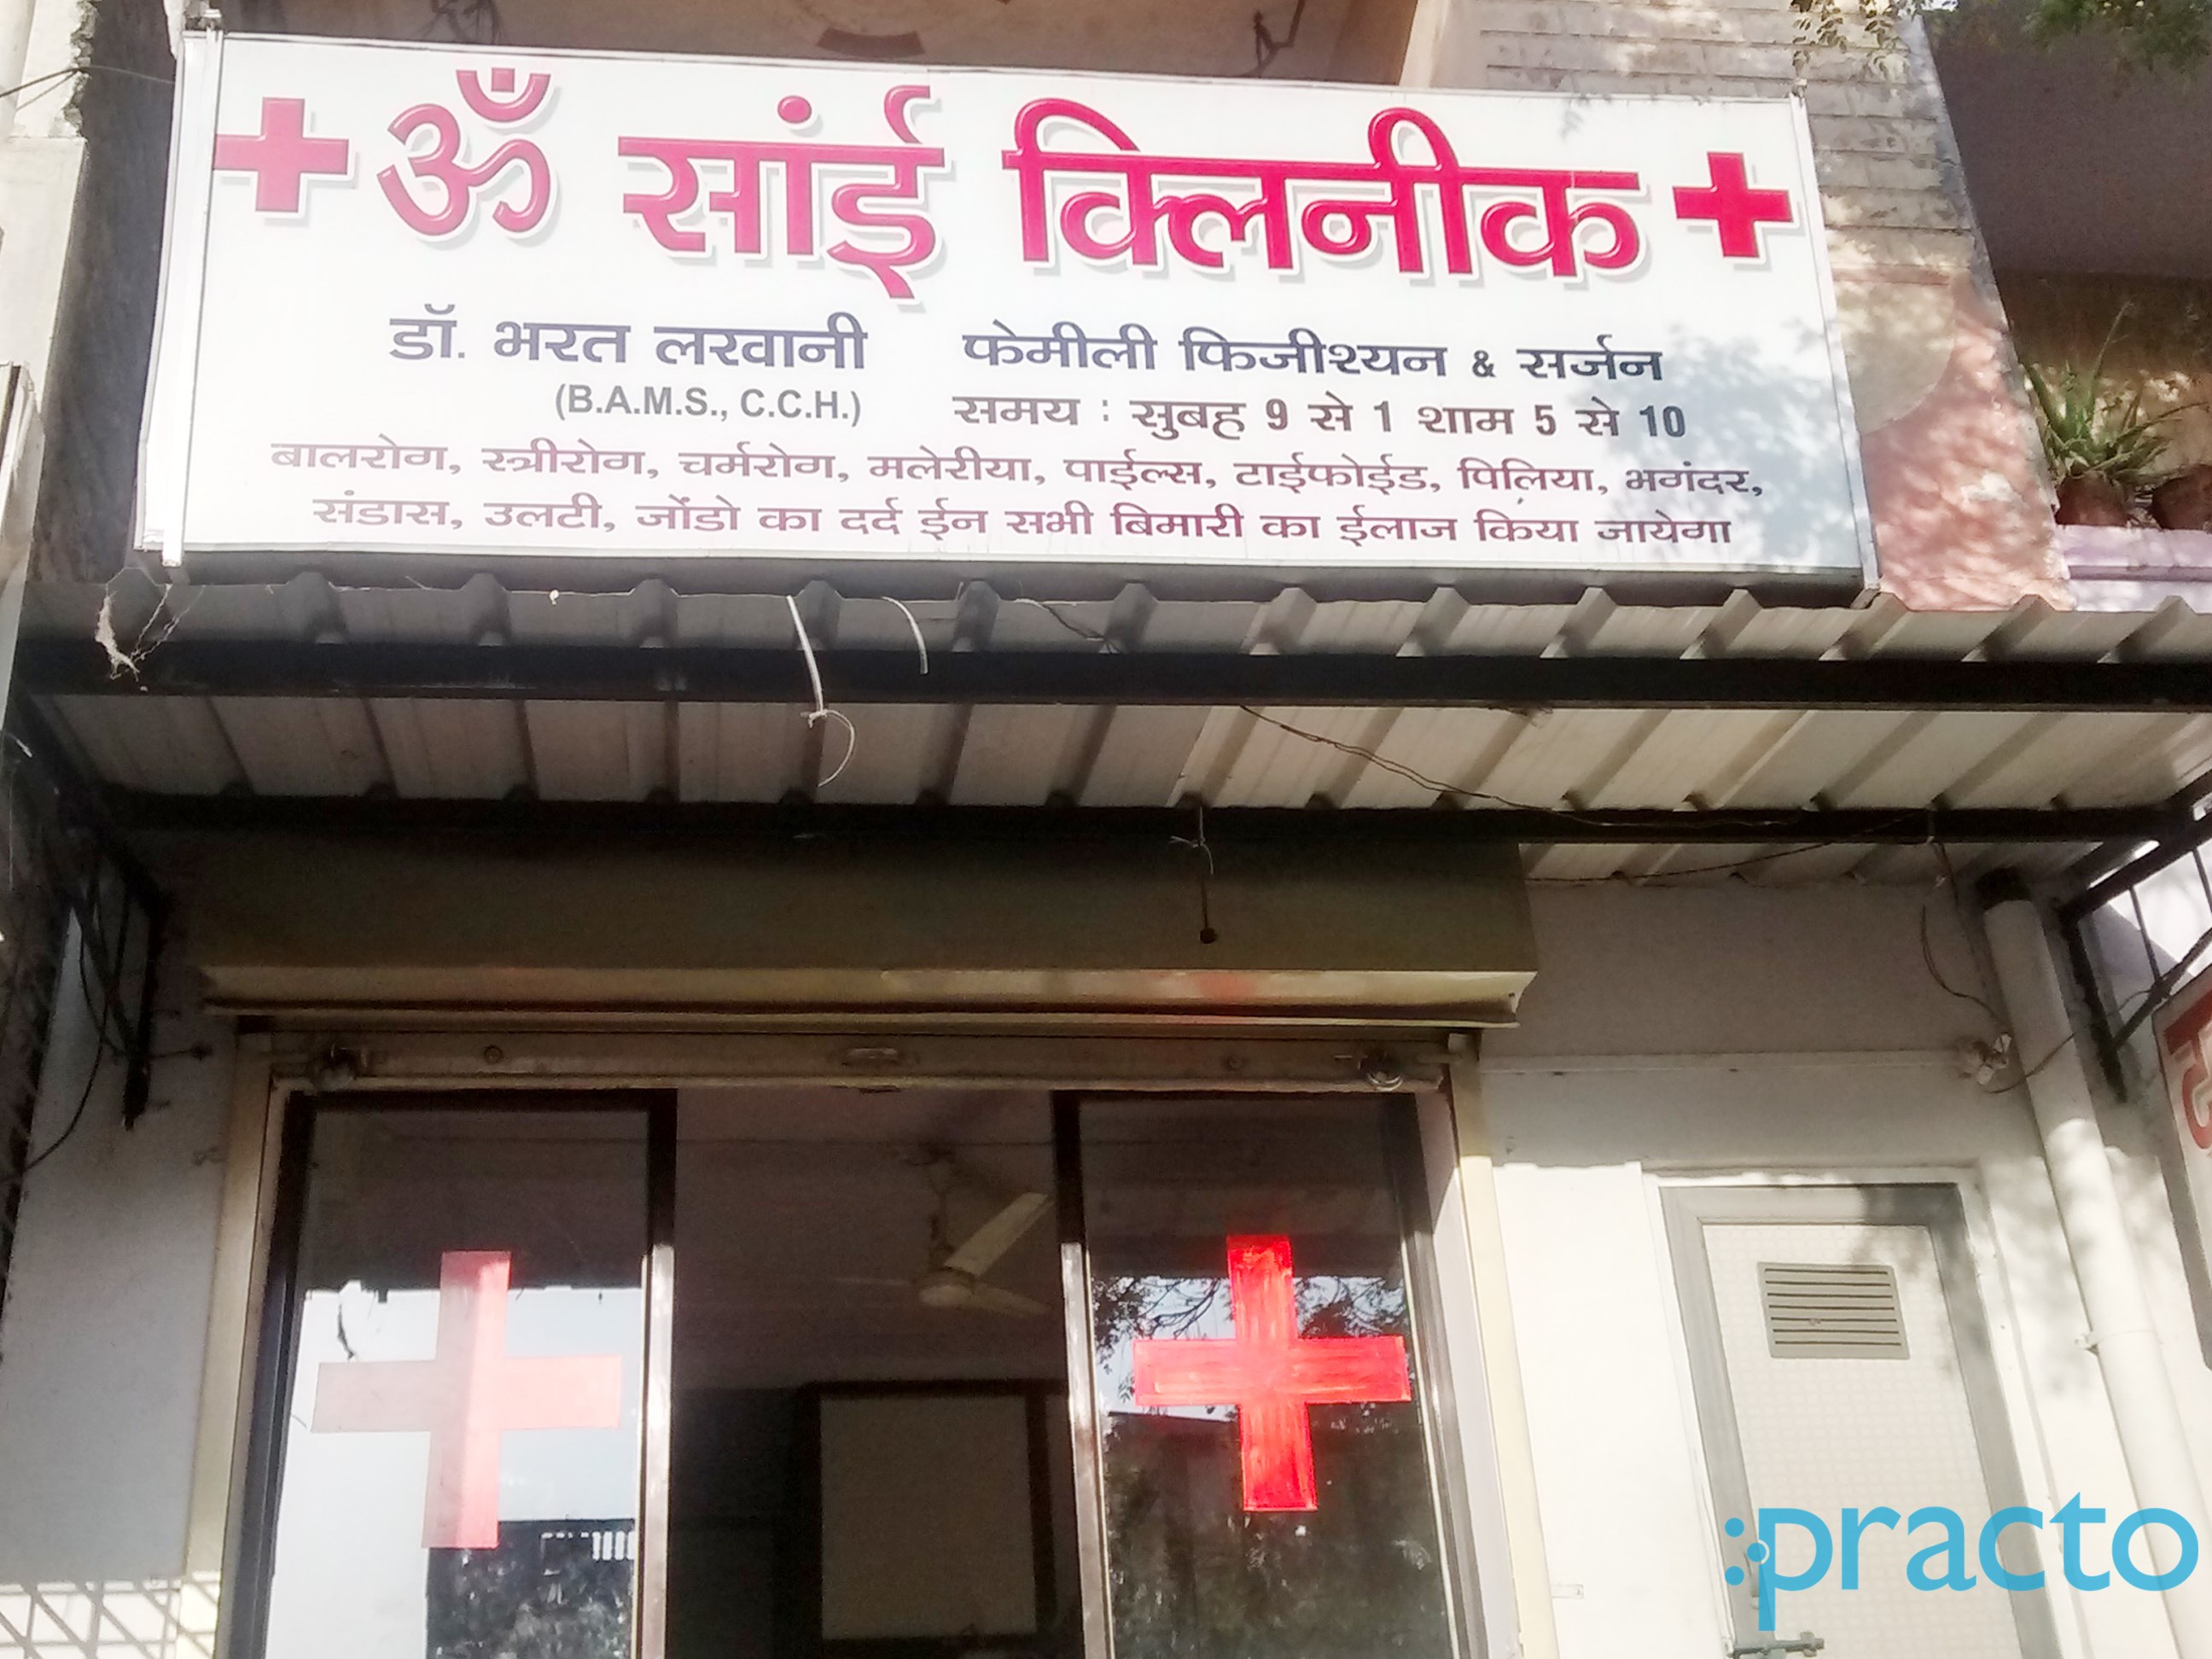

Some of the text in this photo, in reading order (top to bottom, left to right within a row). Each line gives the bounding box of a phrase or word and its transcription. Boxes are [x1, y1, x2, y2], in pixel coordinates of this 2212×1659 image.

[1001, 97, 1639, 277] क्लिनीक
[388, 302, 466, 362] डॉ.
[493, 321, 632, 364] भरत
[962, 318, 1158, 370] फेमीली
[1471, 350, 1496, 378] &
[1516, 334, 1663, 381] सर्जन
[555, 383, 861, 428] (B.A.M.S., C.C.H.)
[952, 396, 1081, 426] समय
[1129, 400, 1247, 441] सुबह
[1266, 398, 1289, 431] 9
[1307, 390, 1353, 432] से
[1373, 400, 1392, 433] 1
[1417, 406, 1515, 435] शाम
[1534, 404, 1557, 436] 5
[1575, 395, 1621, 437] से
[1639, 405, 1686, 438] 10
[271, 433, 1763, 498] बालरोग, स्त्रीरोग, चर्मरोग, मलेरीया, पाईल्स, टाईफोईड, पिलिया, भगंदर,
[311, 489, 463, 530] संडास,
[483, 492, 616, 533] उलटी,
[757, 507, 823, 533] का
[838, 497, 904, 535] दर्द
[917, 497, 989, 541] ईन
[1004, 499, 1095, 535] सभी
[1109, 502, 1245, 538] बिमारी
[1259, 515, 1321, 539] का
[1336, 504, 1458, 547] ईलाज
[1472, 508, 1580, 543] किया
[1594, 508, 1732, 544] जायेगा
